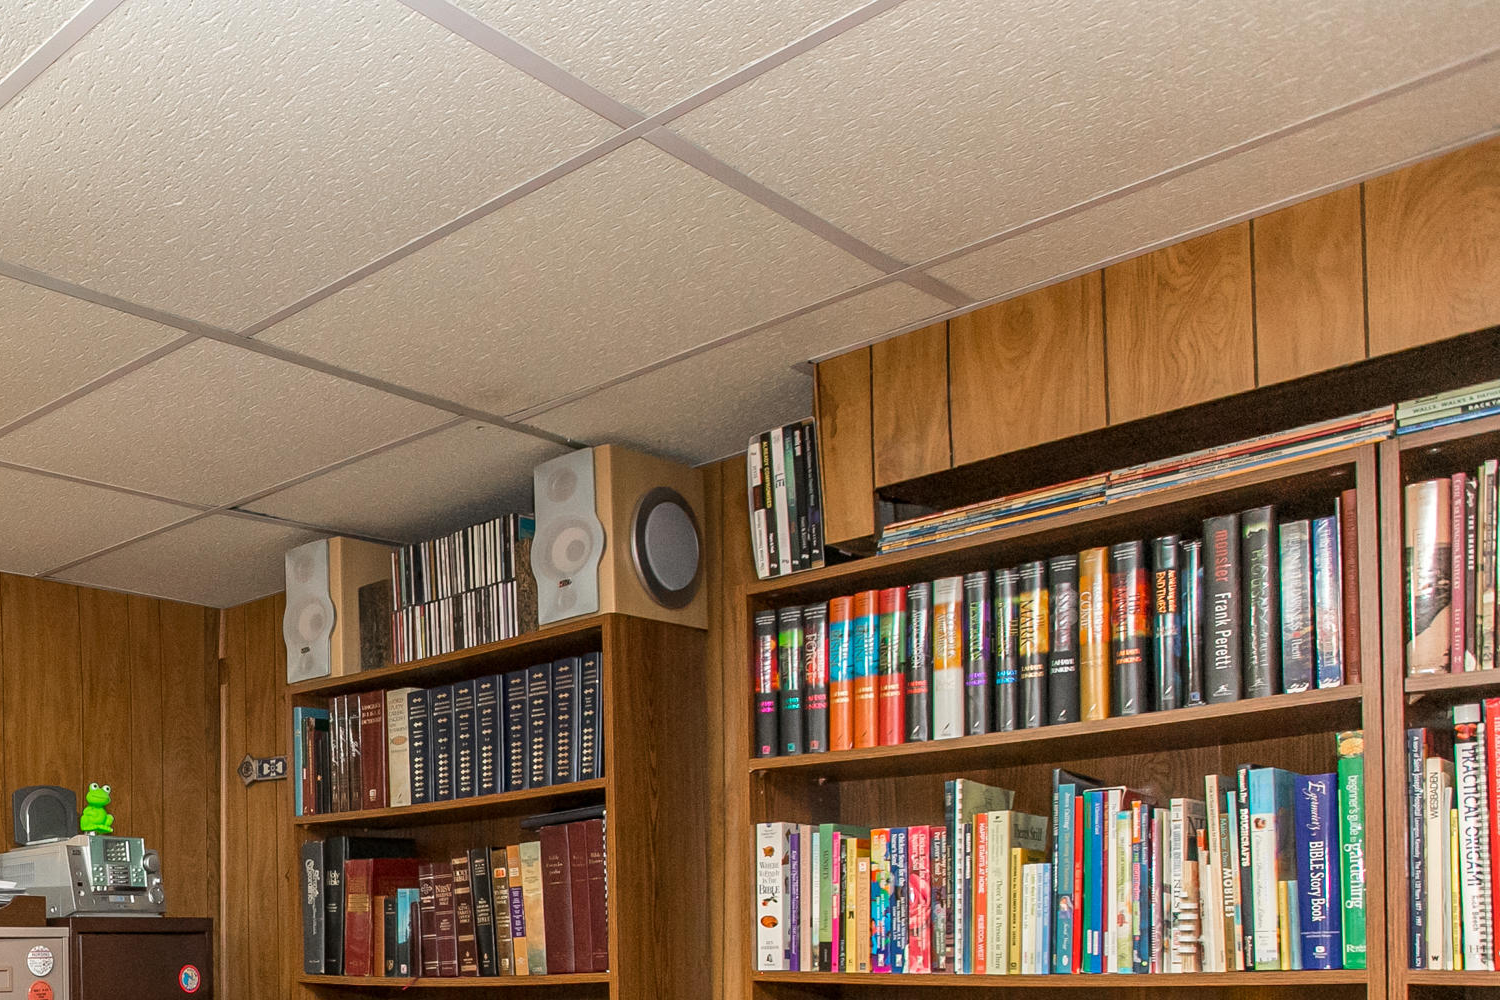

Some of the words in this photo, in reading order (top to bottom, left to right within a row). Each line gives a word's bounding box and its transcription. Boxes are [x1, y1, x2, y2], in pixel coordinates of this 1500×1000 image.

[1214, 529, 1231, 582] monster
[1214, 592, 1232, 626] Frank
[1214, 630, 1232, 670] Peretti
[1346, 775, 1361, 814] beginner's
[1461, 747, 1479, 821] PRACTICAL
[1348, 815, 1363, 836] guide
[1309, 841, 1324, 870] BIBLE
[1465, 827, 1481, 887] ORIGAMI
[1308, 873, 1324, 896] Story
[1344, 843, 1366, 909] gardening
[1311, 899, 1326, 921] Book
